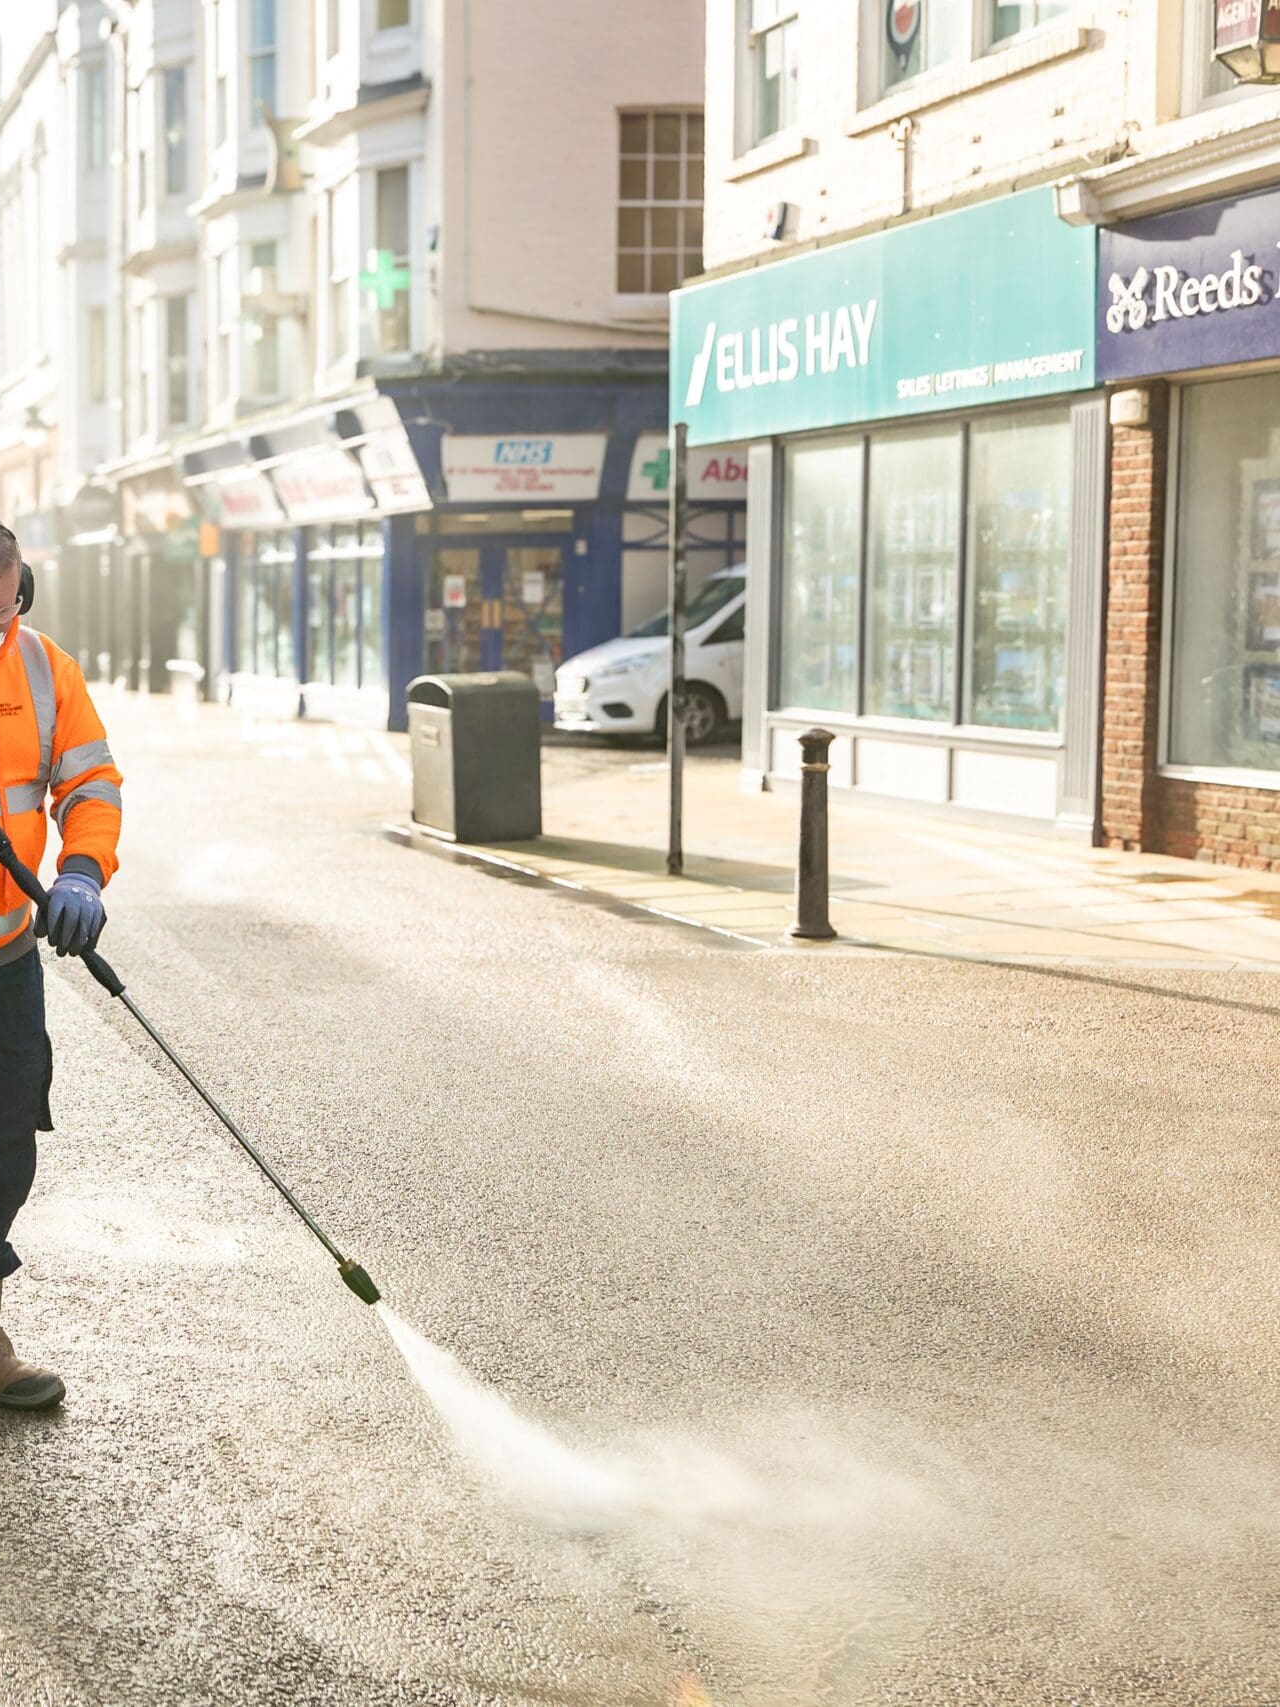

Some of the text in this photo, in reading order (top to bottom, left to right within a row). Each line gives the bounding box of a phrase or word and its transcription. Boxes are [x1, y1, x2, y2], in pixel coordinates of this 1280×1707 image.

[1152, 249, 1262, 321] Reeds
[716, 299, 877, 392] ELLIS HAY
[896, 349, 1084, 400] SALES LETTINGS MANAGEMENT
[499, 440, 549, 464] NHS
